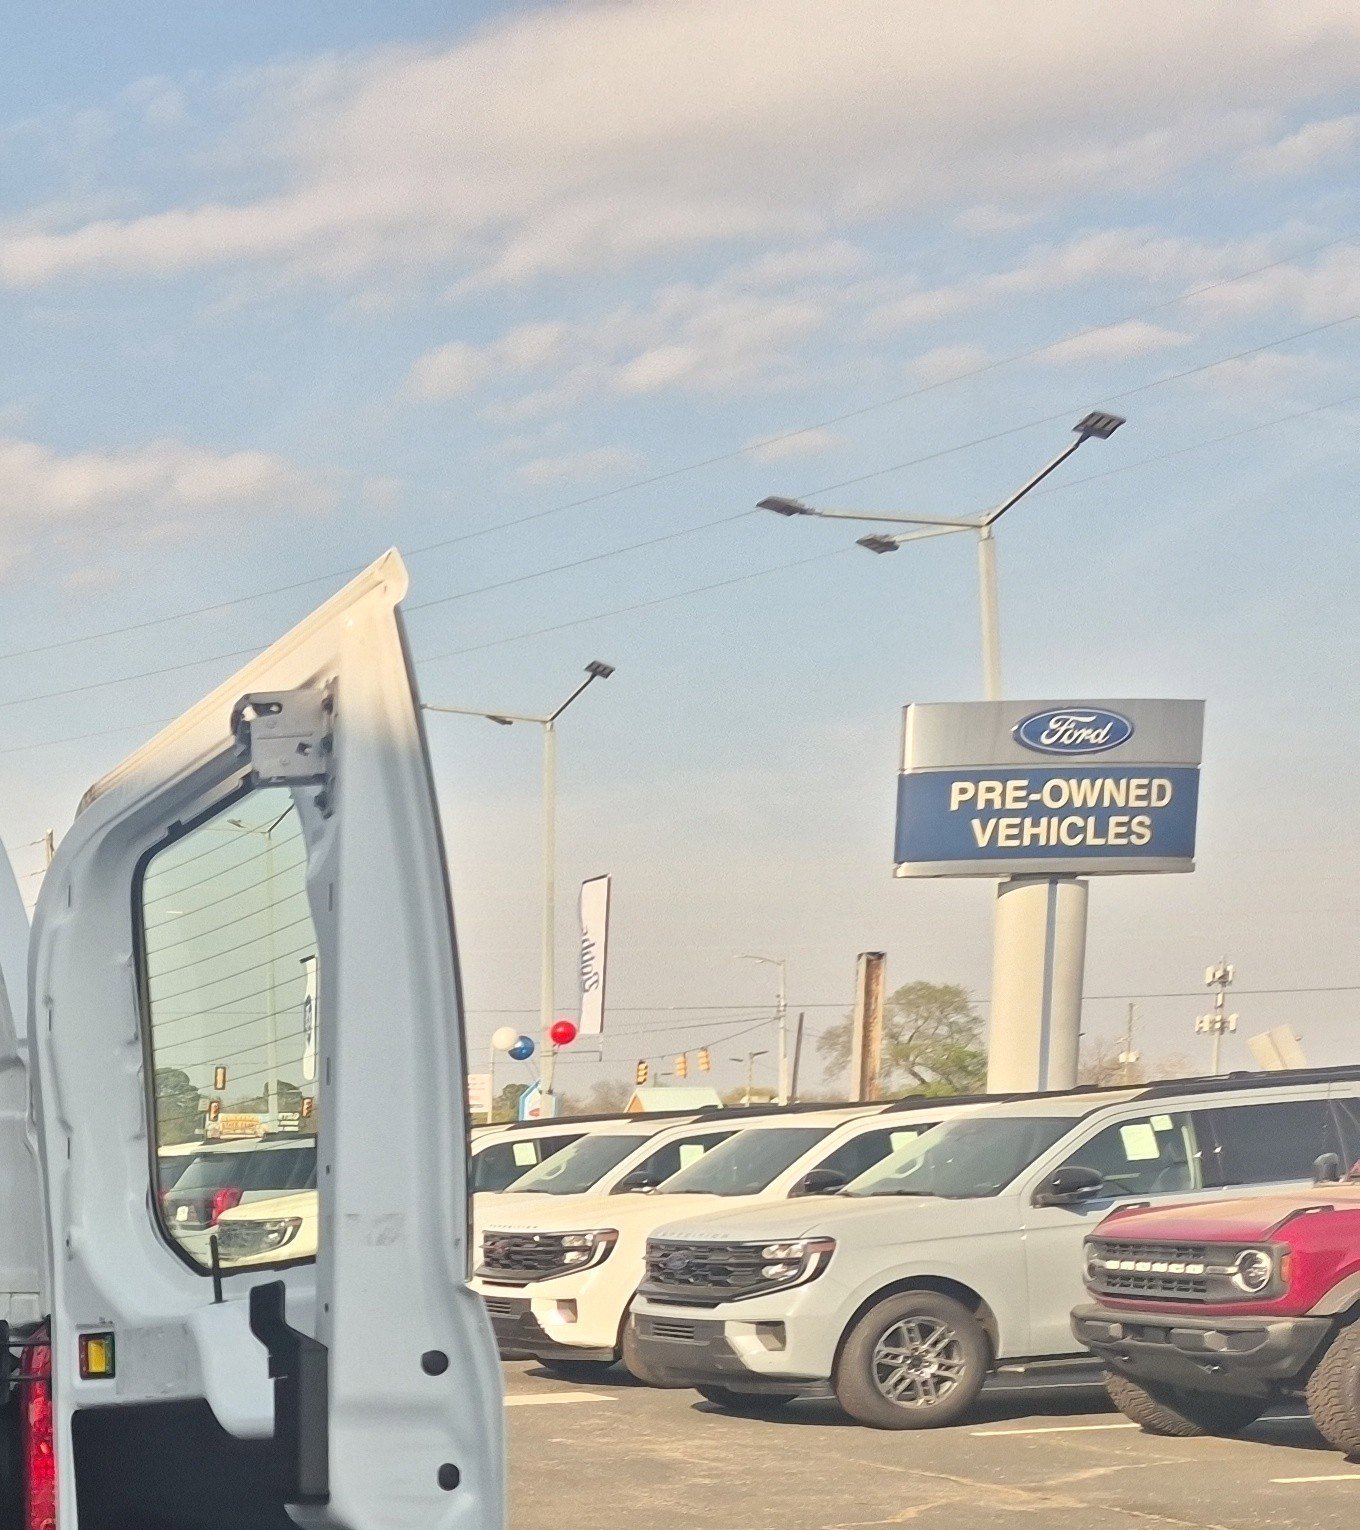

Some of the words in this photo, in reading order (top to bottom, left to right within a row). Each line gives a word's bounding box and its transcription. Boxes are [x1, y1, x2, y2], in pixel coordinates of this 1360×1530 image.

[1041, 715, 1113, 745] Ford
[950, 778, 1173, 811] PRE-OWNED
[971, 816, 1153, 848] VEHICLES
